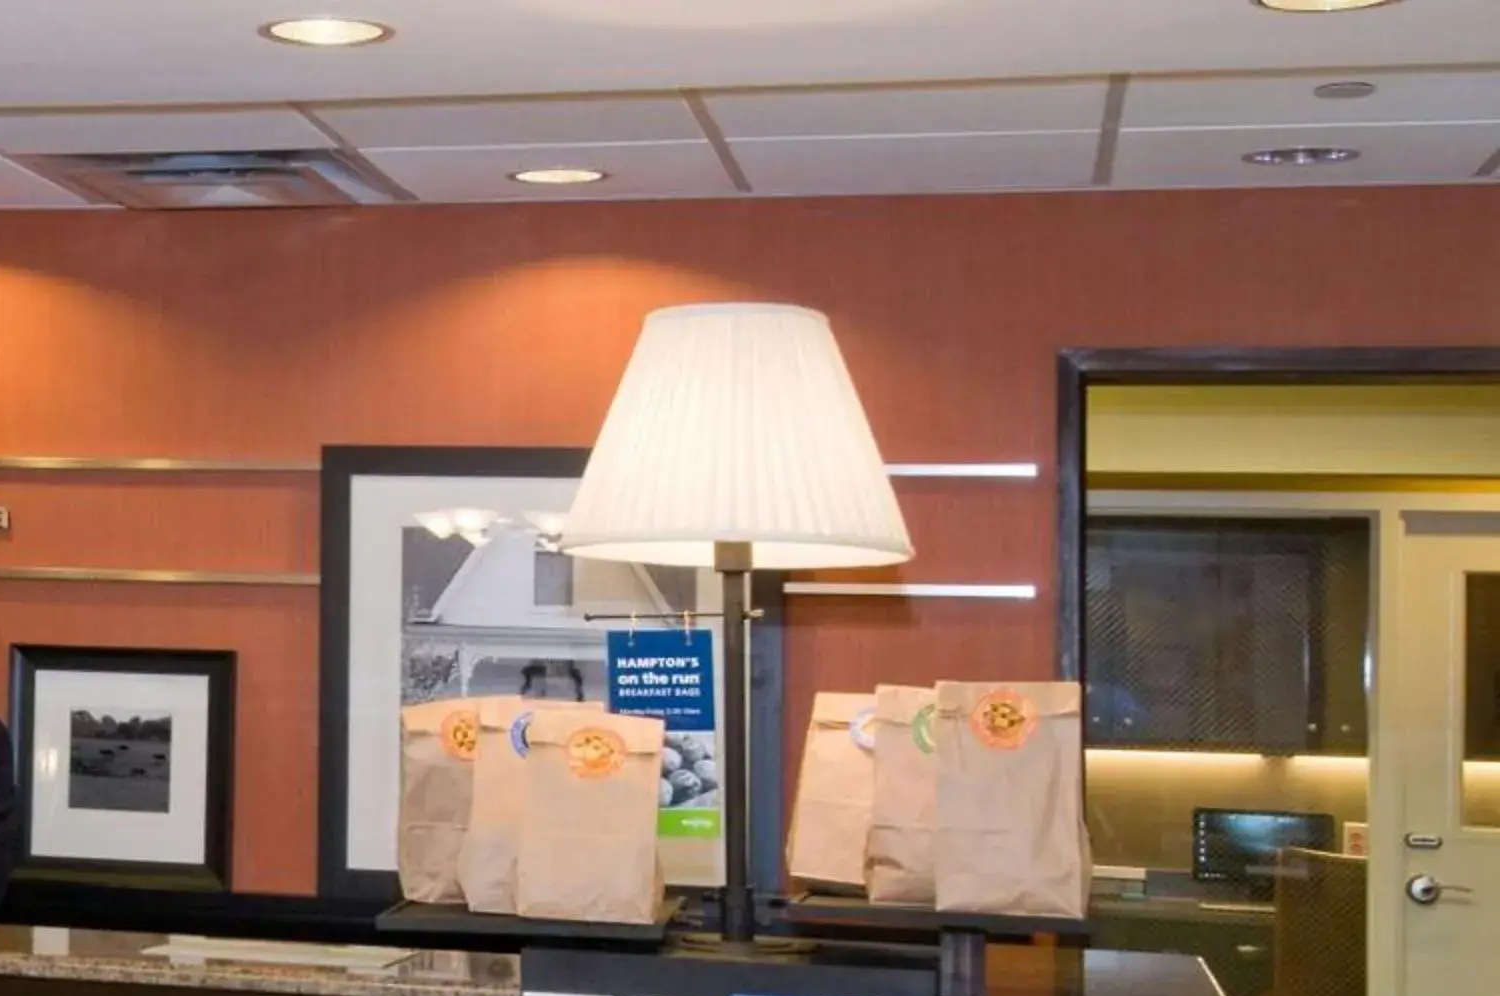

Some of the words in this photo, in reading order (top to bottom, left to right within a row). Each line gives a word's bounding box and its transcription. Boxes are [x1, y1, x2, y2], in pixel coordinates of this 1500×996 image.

[617, 657, 700, 669] HAMPTON'S
[617, 674, 639, 685] on
[642, 672, 669, 685] the
[672, 674, 700, 685] run
[618, 688, 671, 697] BREAKFAST
[675, 688, 701, 697] BAGS
